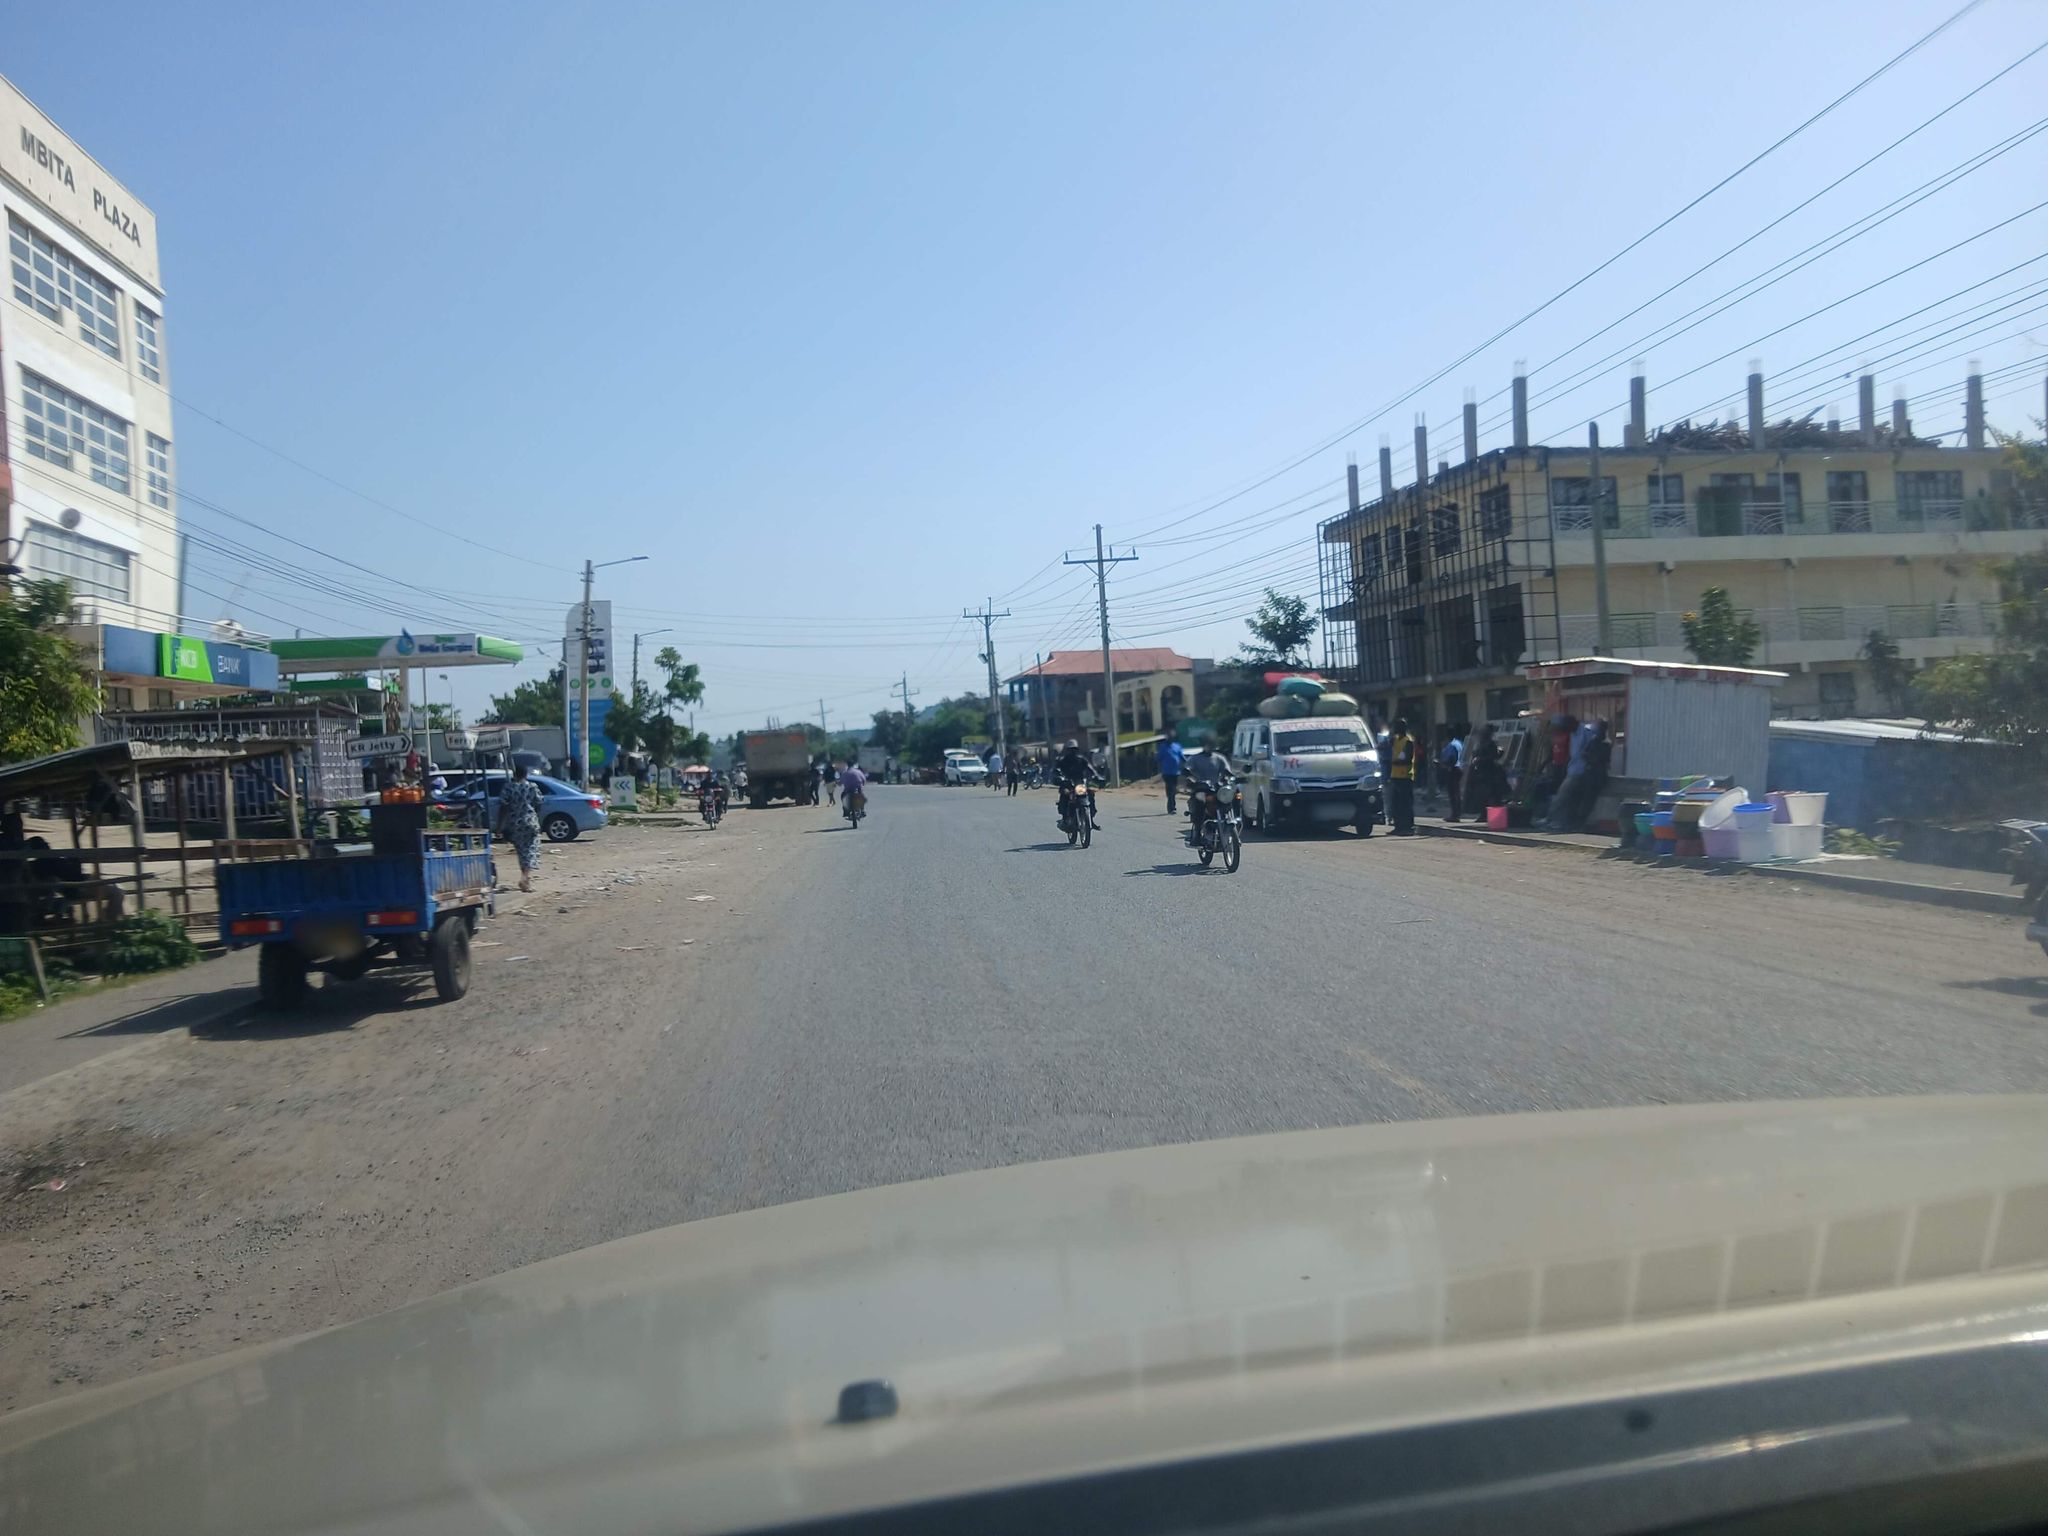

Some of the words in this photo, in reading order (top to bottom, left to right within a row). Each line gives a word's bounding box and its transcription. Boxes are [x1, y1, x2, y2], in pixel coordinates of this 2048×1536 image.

[20, 124, 76, 194] MBITA
[93, 187, 141, 249] PLAZA
[217, 655, 241, 675] BANK
[350, 742, 366, 753] KR
[369, 739, 396, 752] Jetty
